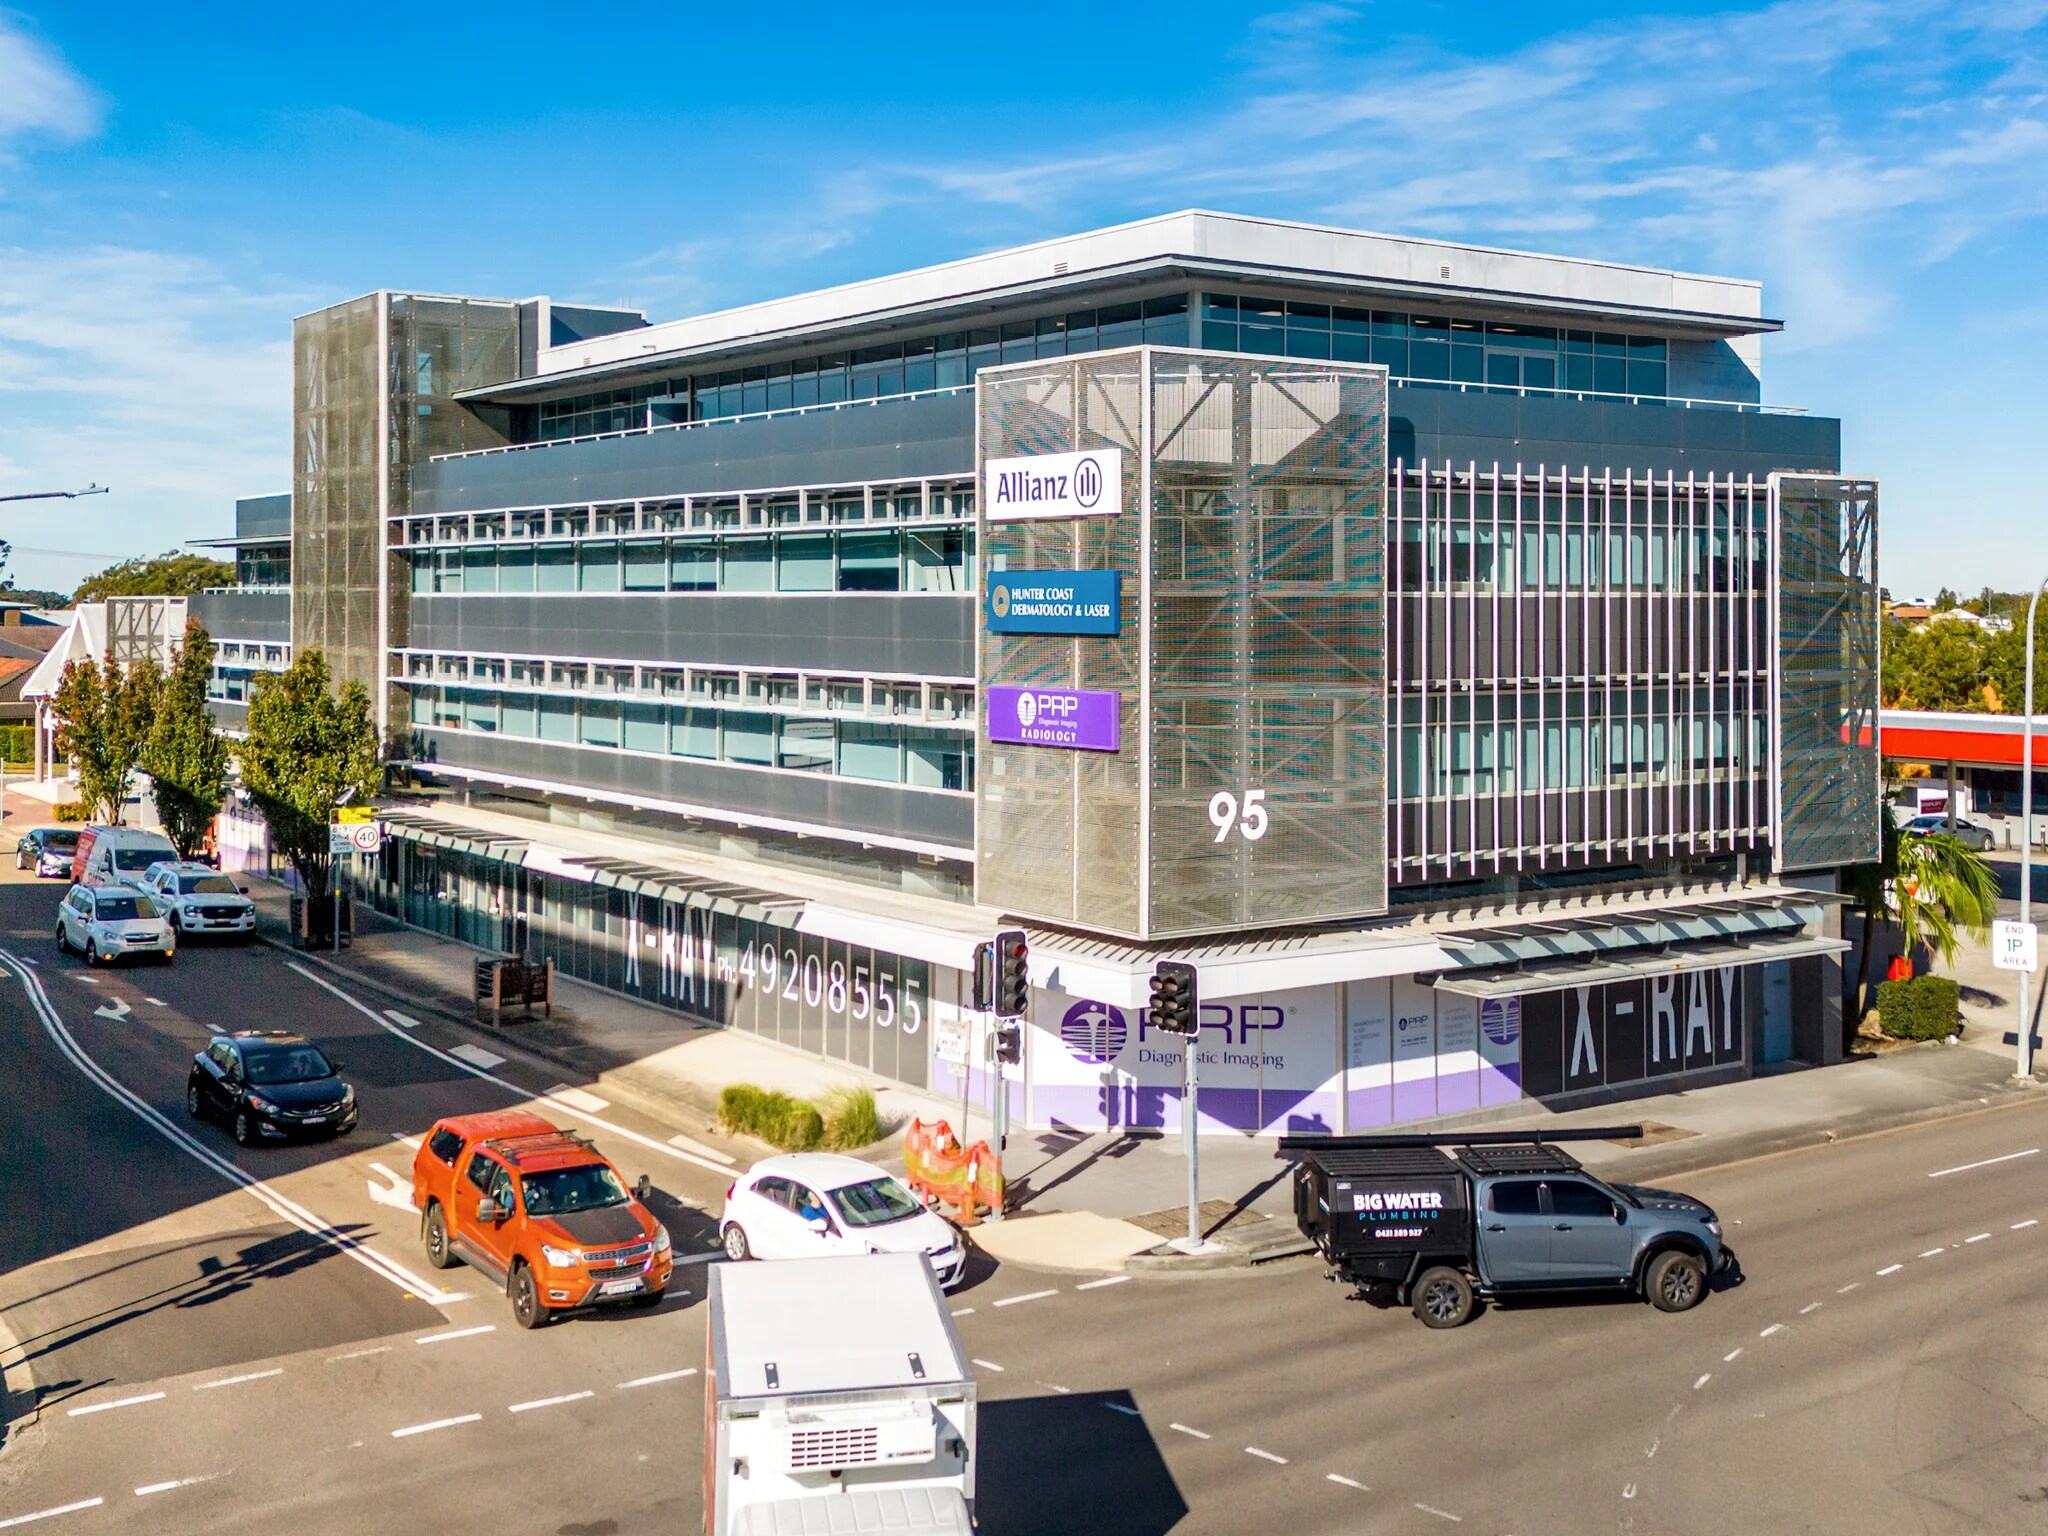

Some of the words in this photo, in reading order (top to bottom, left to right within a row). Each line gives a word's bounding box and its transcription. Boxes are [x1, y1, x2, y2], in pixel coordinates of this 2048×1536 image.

[997, 470, 1067, 503] Allianz
[1012, 588, 1044, 600] HUNTER
[1046, 588, 1074, 600] COAST
[1012, 604, 1073, 616] DERMATOLOGY
[1075, 605, 1082, 616] &
[1084, 604, 1110, 617] LASER
[1038, 695, 1078, 717] PRP
[1021, 728, 1076, 742] RADIOLOGY
[1209, 789, 1268, 843] 95
[359, 832, 375, 842] 40
[2005, 925, 2024, 935] END
[2007, 938, 2023, 952] 1P
[626, 892, 714, 1008] X-RAY
[717, 956, 737, 984] Ph:
[740, 940, 921, 1034] 49208555
[2002, 956, 2027, 967] AREA
[1570, 966, 1734, 1077] X-RAY
[1139, 1050, 1218, 1068] Diagnstic
[1223, 1051, 1284, 1069] Imaging
[1353, 1194, 1383, 1211] BIG
[1383, 1192, 1443, 1210] WATER
[1359, 1210, 1438, 1221] PLUMBING
